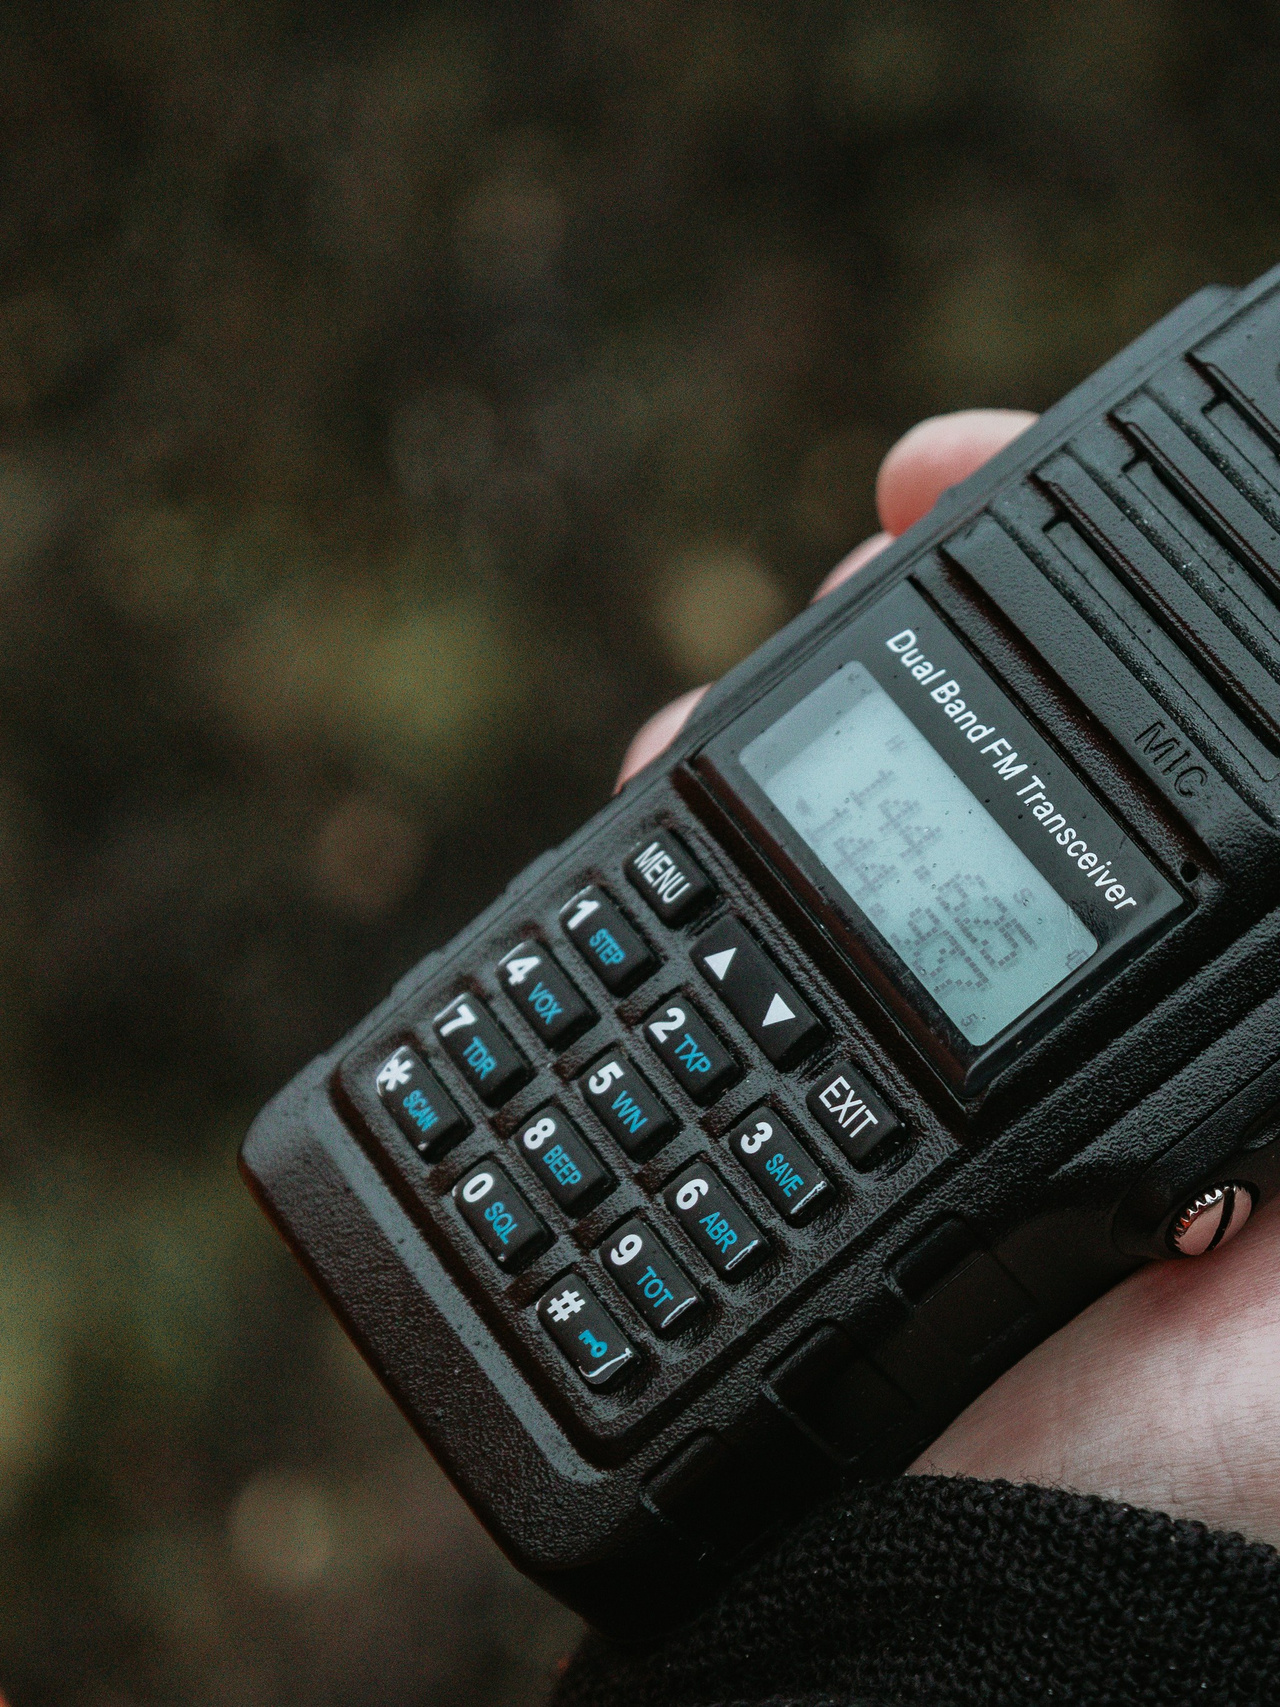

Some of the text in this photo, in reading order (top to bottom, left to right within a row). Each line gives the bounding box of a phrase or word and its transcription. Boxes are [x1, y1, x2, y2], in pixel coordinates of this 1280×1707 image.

[886, 629, 1136, 909] Dual Band FM Transceiver
[1134, 720, 1208, 798] MIC
[634, 842, 689, 902] MENU
[568, 901, 626, 964] 1 STEP
[507, 957, 563, 1024] 4 VOX
[442, 1005, 497, 1080] 7 TDR
[649, 1008, 712, 1072] 2 TXP
[403, 1090, 438, 1131] SCAN
[589, 1062, 648, 1133] 5 WN
[819, 1076, 878, 1137] EXIT
[524, 1118, 582, 1185] 8 BEEP
[741, 1122, 804, 1197] 3 SAVE
[463, 1173, 518, 1244] 0 SQL
[677, 1179, 737, 1255] 6 ABR
[547, 1290, 585, 1321] #
[611, 1234, 674, 1308] 9 TOT
